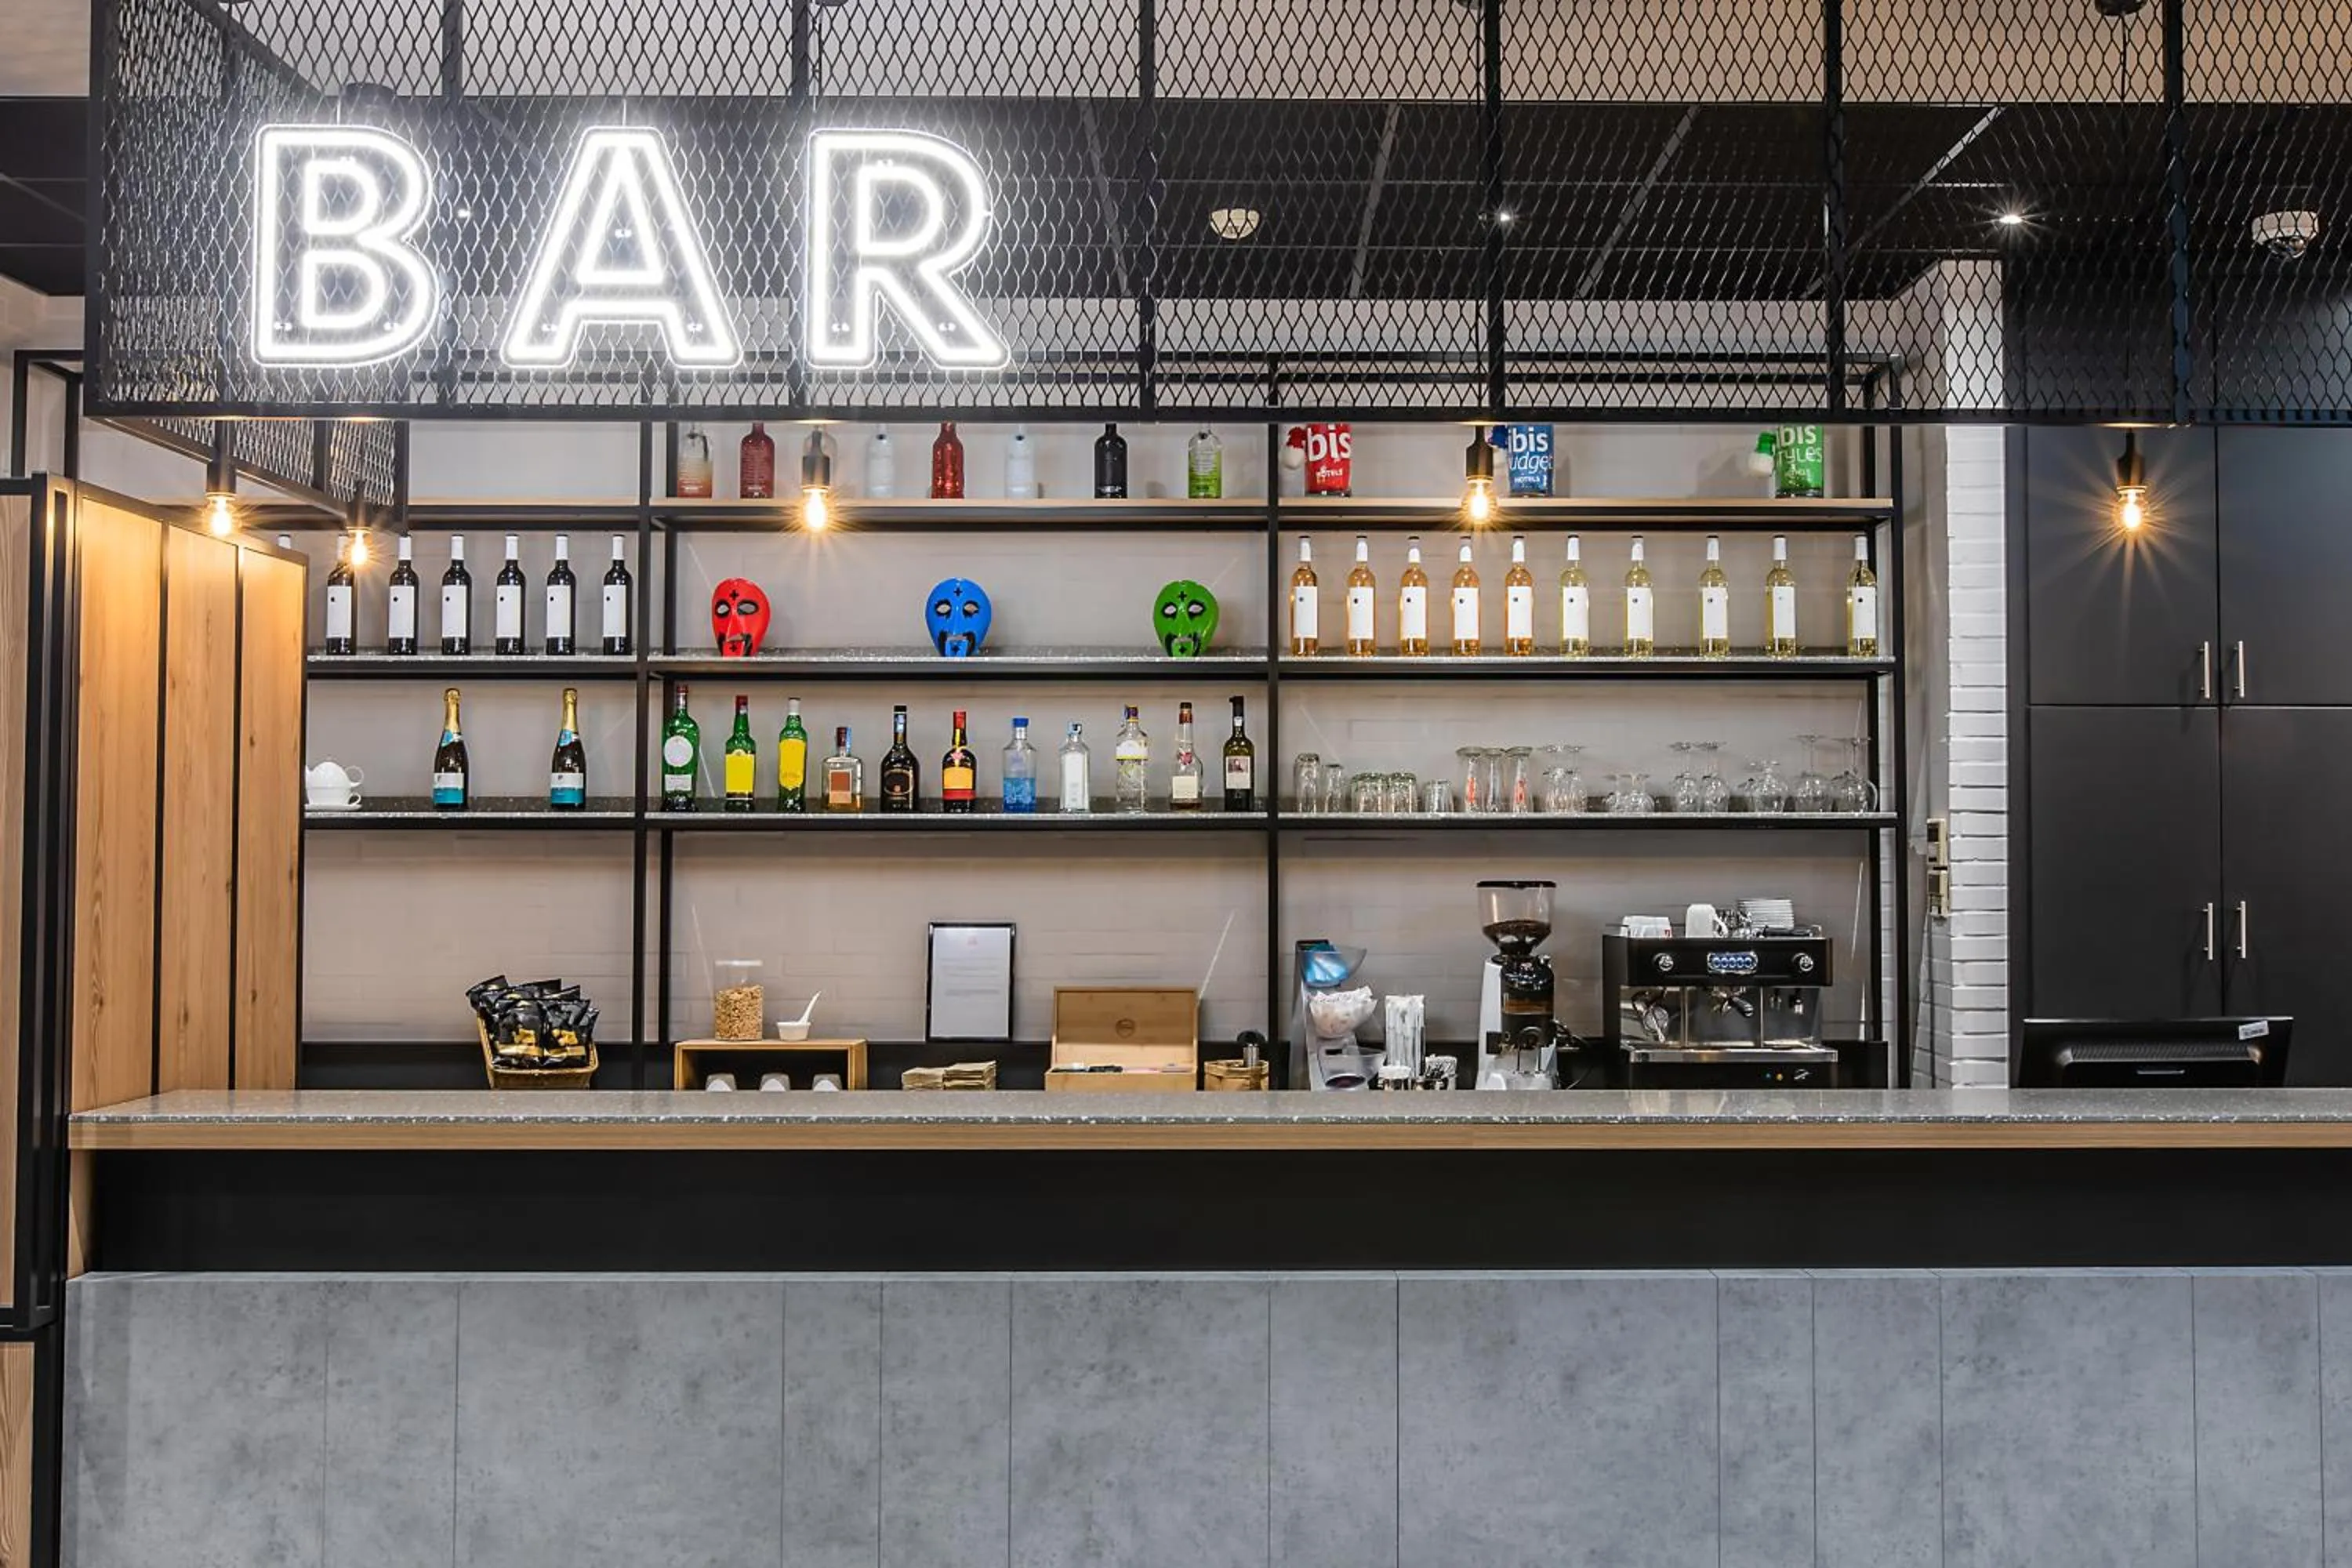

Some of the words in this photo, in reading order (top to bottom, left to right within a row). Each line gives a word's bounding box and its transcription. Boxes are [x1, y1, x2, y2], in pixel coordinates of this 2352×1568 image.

[252, 123, 1011, 369] BAR
[1306, 424, 1351, 462] bis
[1508, 426, 1548, 452] ibis
